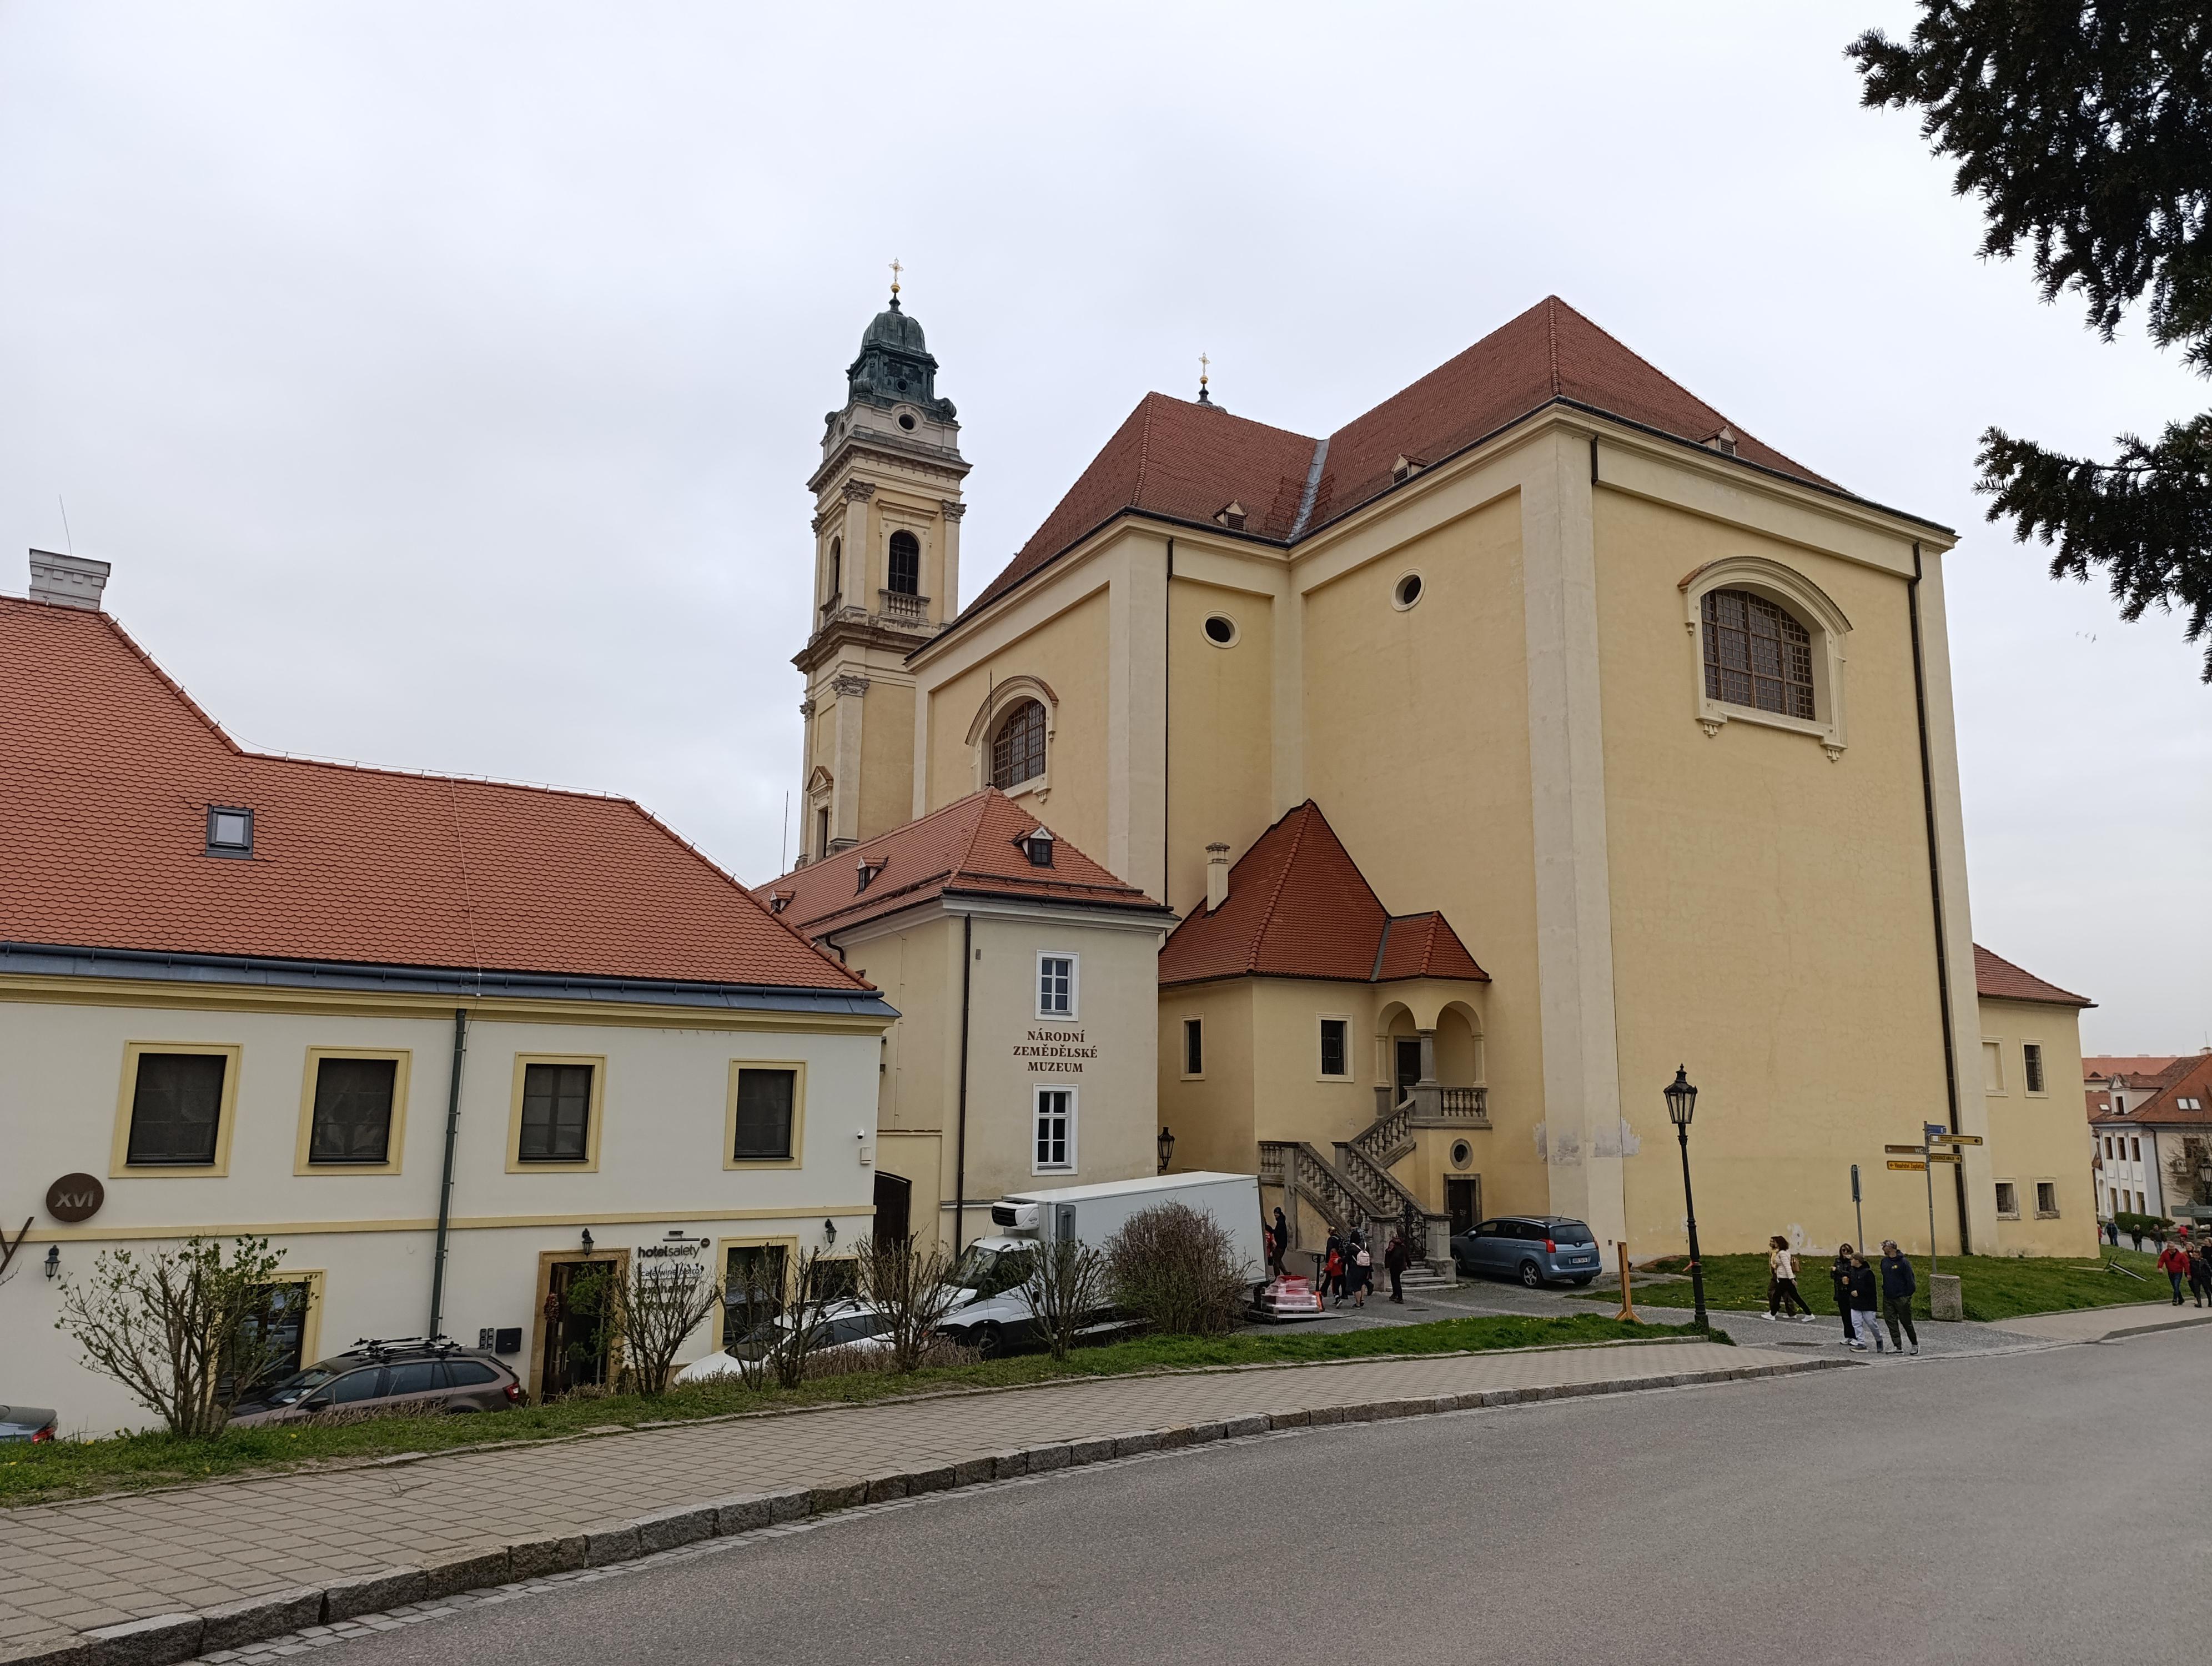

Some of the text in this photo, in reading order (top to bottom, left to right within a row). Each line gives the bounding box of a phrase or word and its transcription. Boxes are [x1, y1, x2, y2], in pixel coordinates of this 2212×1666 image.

[1027, 1028, 1085, 1042] NÁRODNÍ
[1013, 1044, 1097, 1058] ZEMĚDĚLSKÉ
[1028, 1062, 1083, 1072] MUZEUM
[55, 1191, 94, 1207] XVI
